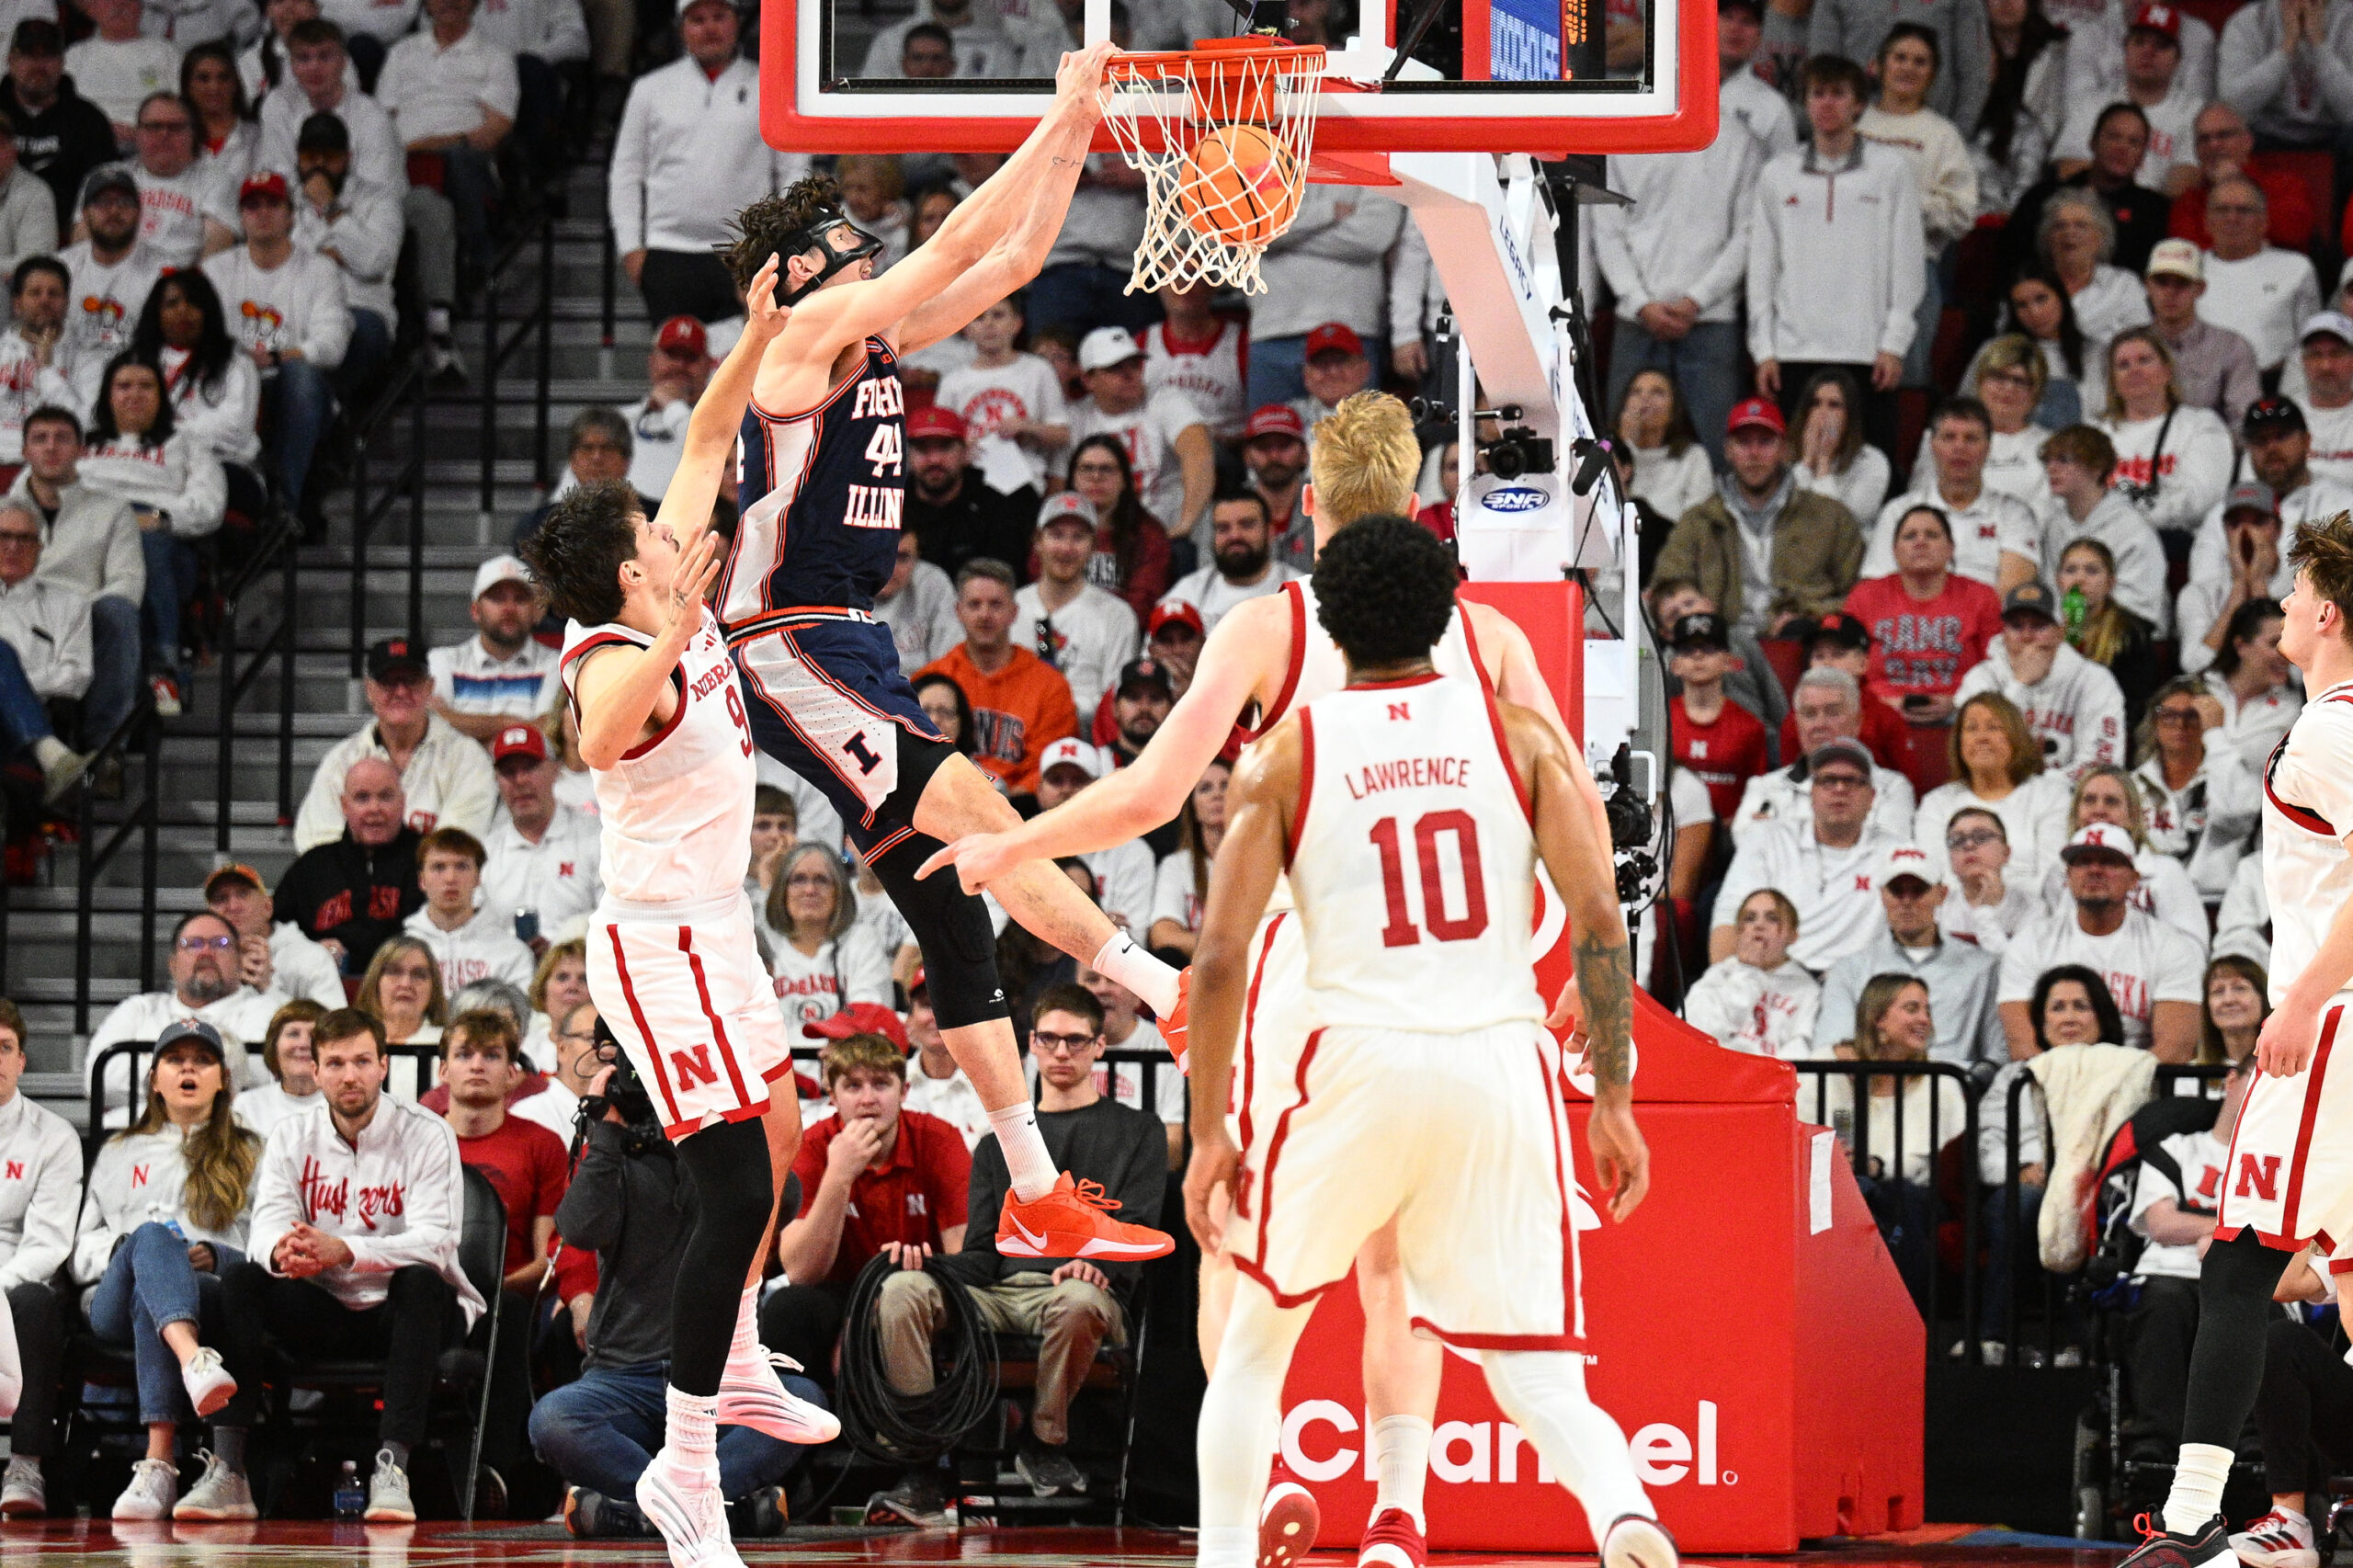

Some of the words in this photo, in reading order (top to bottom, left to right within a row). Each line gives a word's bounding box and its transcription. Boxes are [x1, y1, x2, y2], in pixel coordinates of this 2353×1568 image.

[865, 422, 903, 478] 44
[1483, 492, 1545, 505] SNA
[724, 684, 753, 759] 9
[1387, 703, 1411, 722] N
[842, 729, 883, 778] I
[1346, 757, 1471, 801] LAWRENCE
[1370, 809, 1489, 949] 10
[669, 1042, 719, 1093] N
[6, 1160, 25, 1179] N
[133, 1164, 150, 1189] N
[2234, 1153, 2283, 1202] N
[1280, 1400, 1717, 1486] Canel
